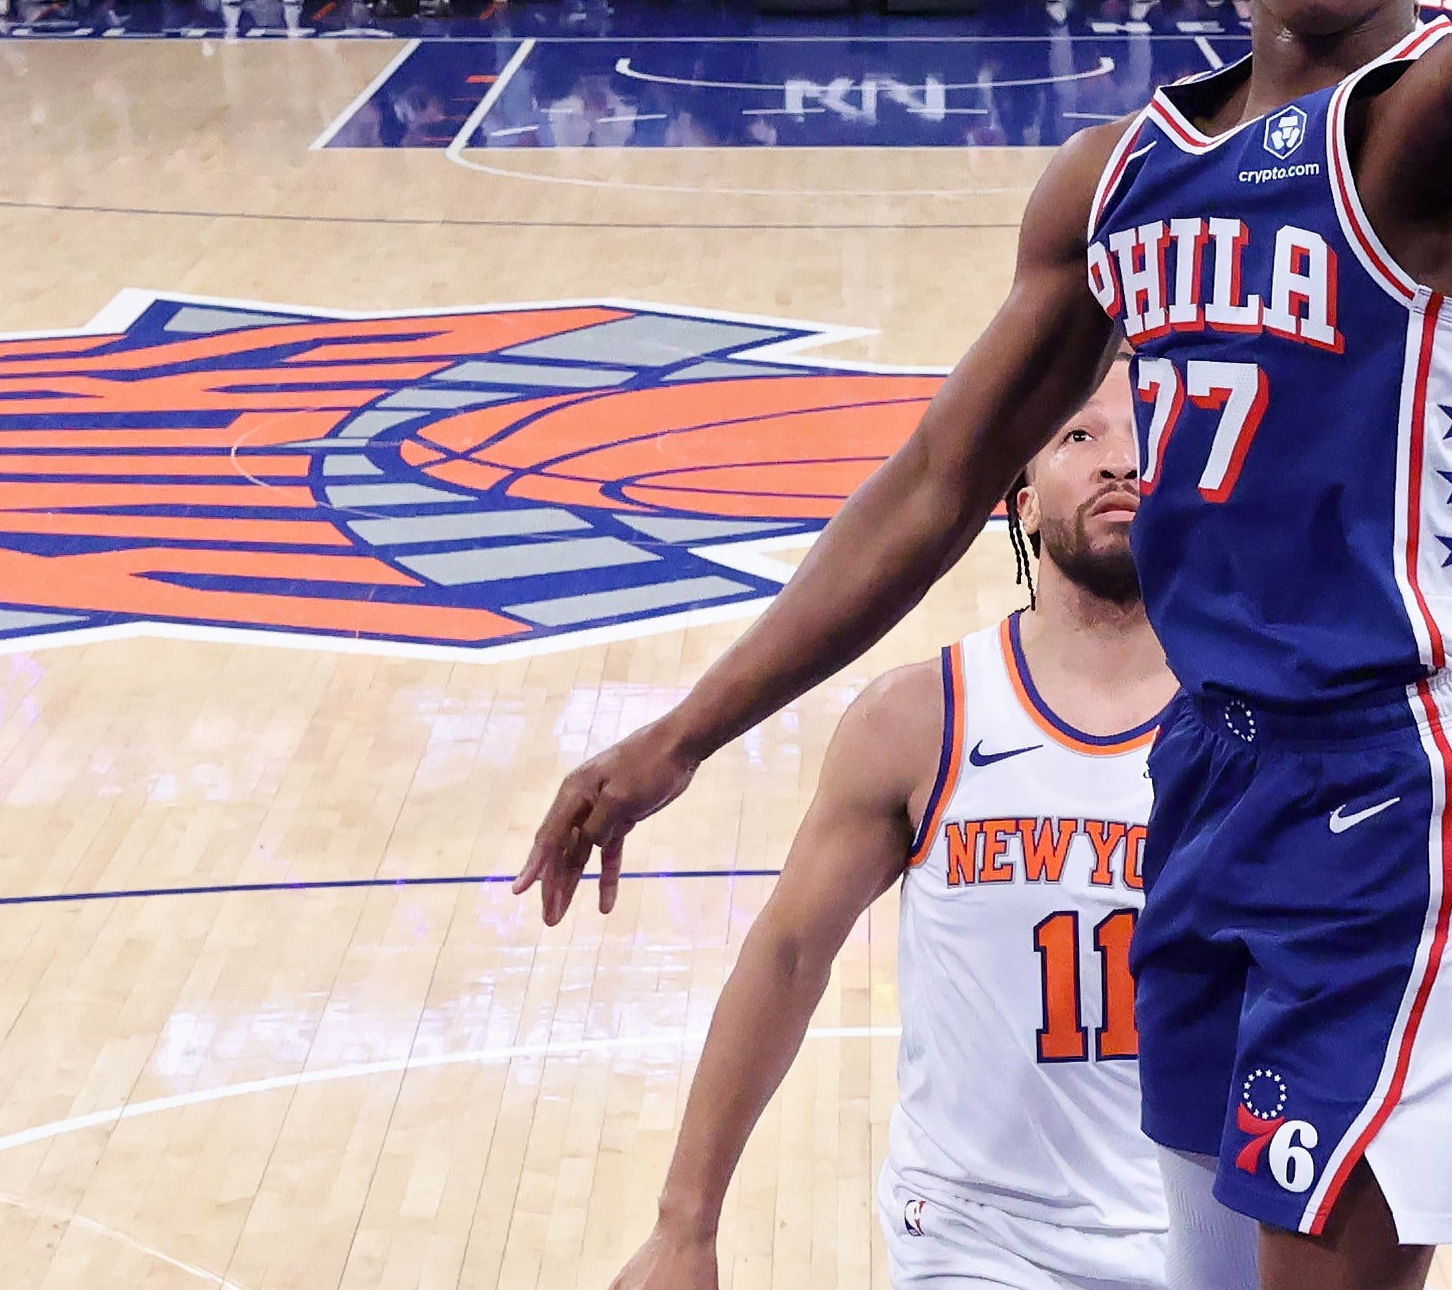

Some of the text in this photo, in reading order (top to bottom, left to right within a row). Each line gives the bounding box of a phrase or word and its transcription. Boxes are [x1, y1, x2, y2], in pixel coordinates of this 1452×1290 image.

[1238, 160, 1320, 184] crypto.com
[1088, 217, 1345, 355] PHILA
[1136, 357, 1270, 504] 77
[945, 816, 1149, 890] NEW YO
[1034, 909, 1140, 1064] 11
[1237, 1102, 1319, 1193] 76
